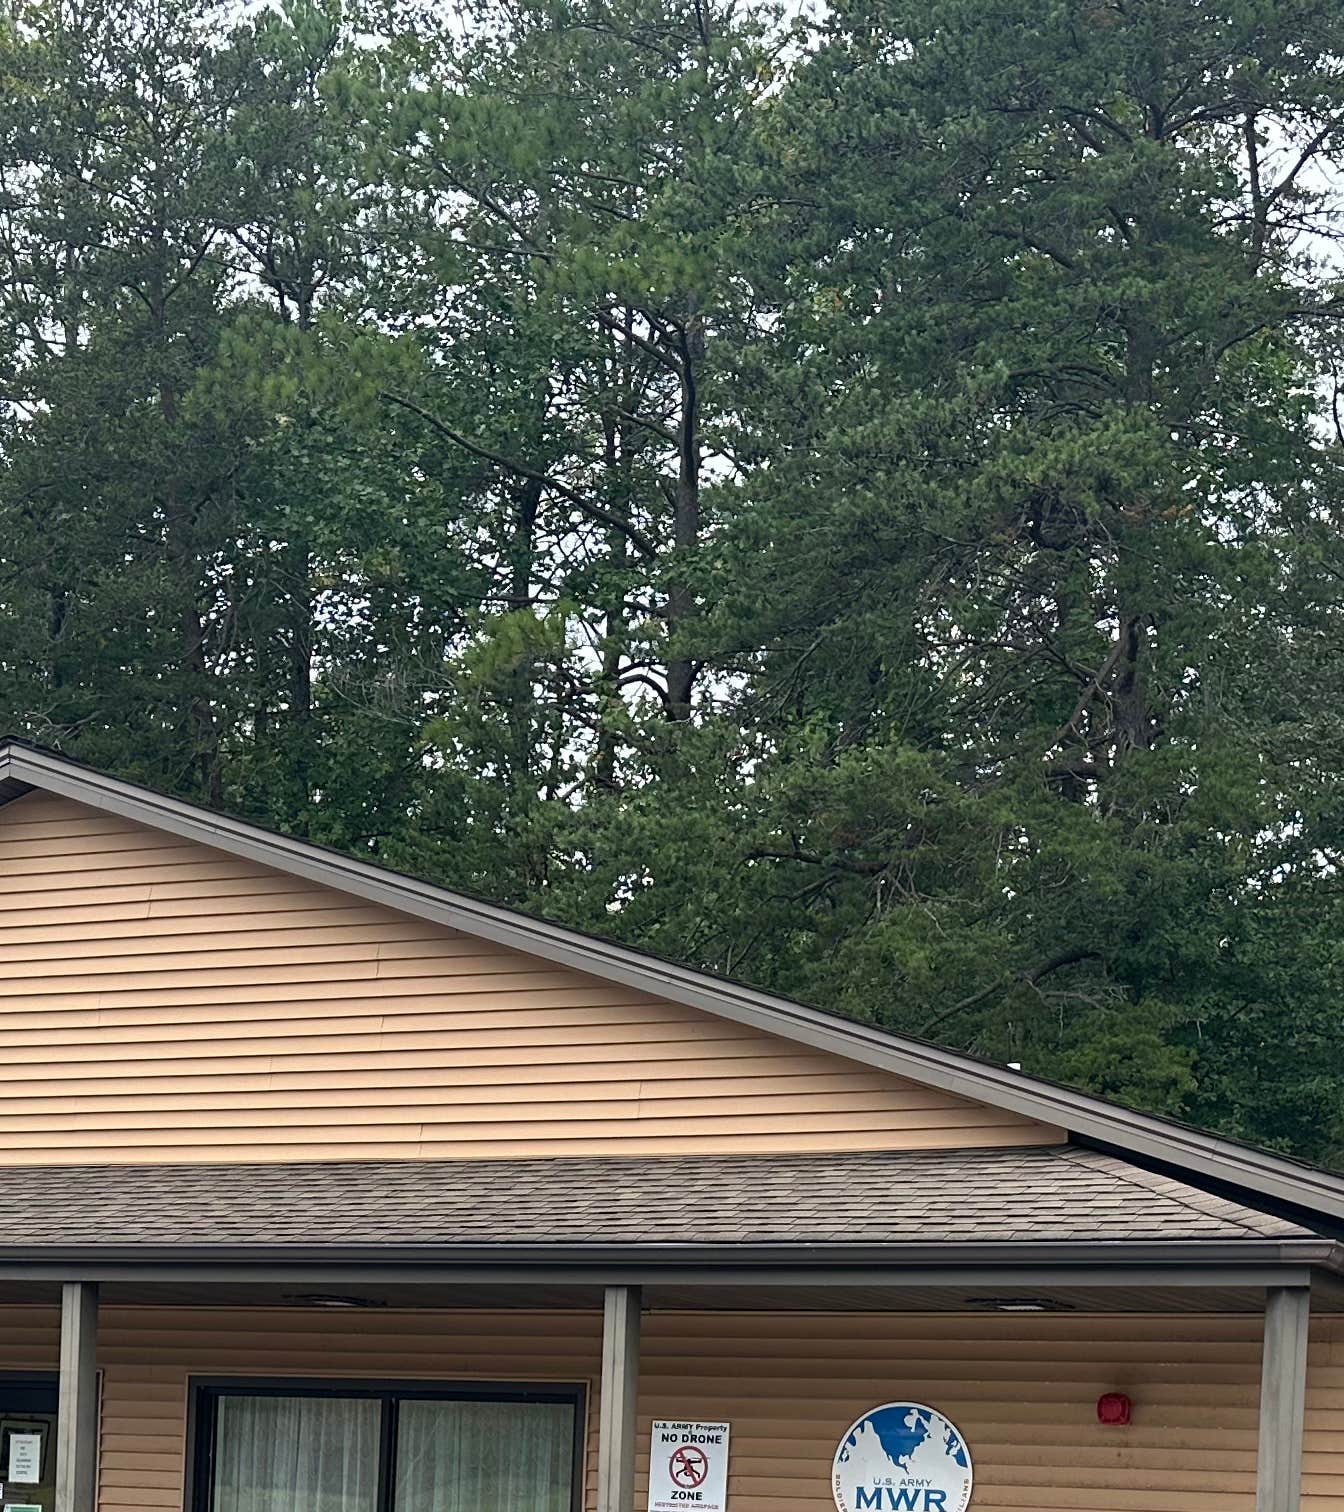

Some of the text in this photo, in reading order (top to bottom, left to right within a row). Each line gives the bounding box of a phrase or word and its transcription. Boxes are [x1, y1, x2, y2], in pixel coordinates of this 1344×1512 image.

[695, 1424, 727, 1432] Property
[661, 1433, 723, 1444] NO DRONE
[873, 1477, 933, 1487] U.S. ARMY
[670, 1490, 703, 1501] ZONE
[856, 1486, 947, 1512] MWR
